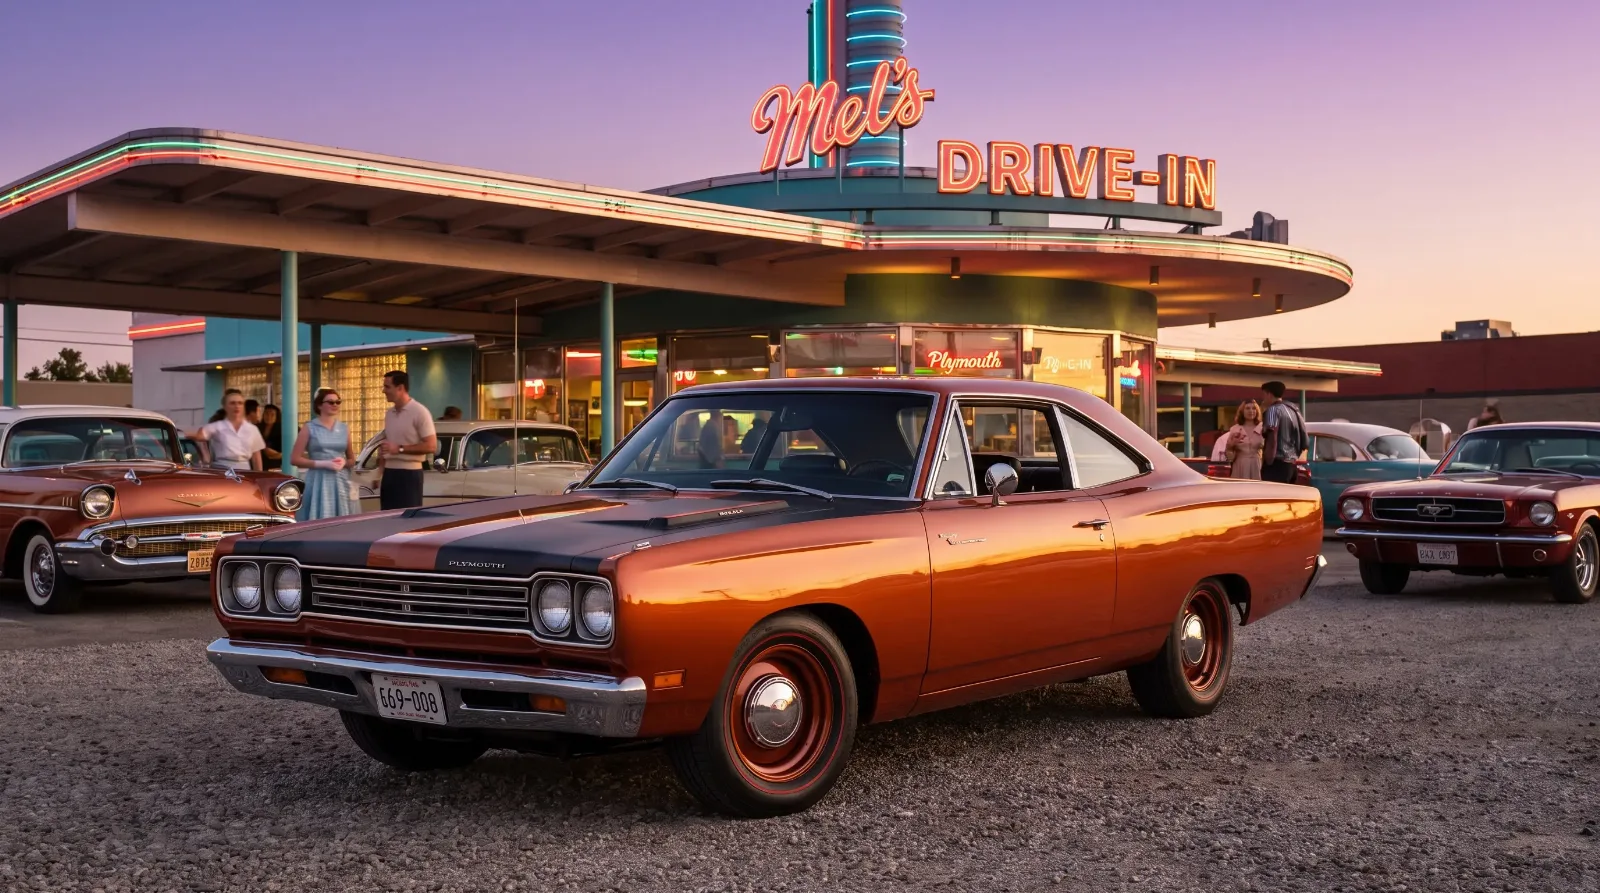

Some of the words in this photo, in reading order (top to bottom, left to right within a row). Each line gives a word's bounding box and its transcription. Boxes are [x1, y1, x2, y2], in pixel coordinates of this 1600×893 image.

[750, 56, 935, 173] Mel's
[937, 139, 1216, 210] DRIVE-IN
[927, 350, 1002, 375] Plymouth
[448, 560, 506, 569] PLYMOUTH
